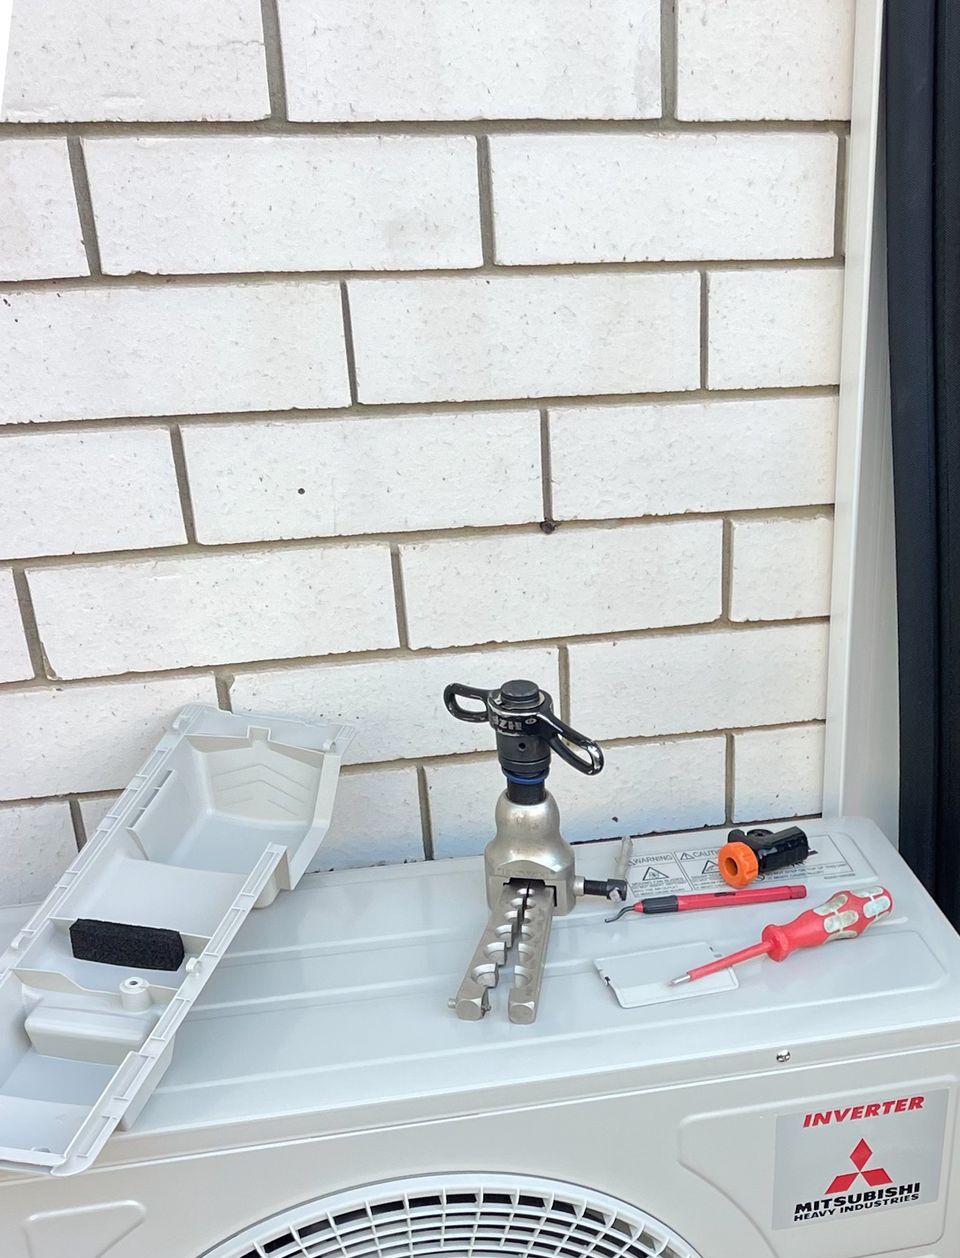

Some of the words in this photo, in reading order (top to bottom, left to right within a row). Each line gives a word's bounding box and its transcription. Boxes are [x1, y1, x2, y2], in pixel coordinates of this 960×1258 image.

[632, 854, 673, 866] WARNING
[803, 1096, 924, 1128] INVERTER
[794, 1208, 836, 1222] HEAVY
[840, 1193, 919, 1213] INDUSTRIES
[795, 1182, 920, 1214] MITSUBISHI
